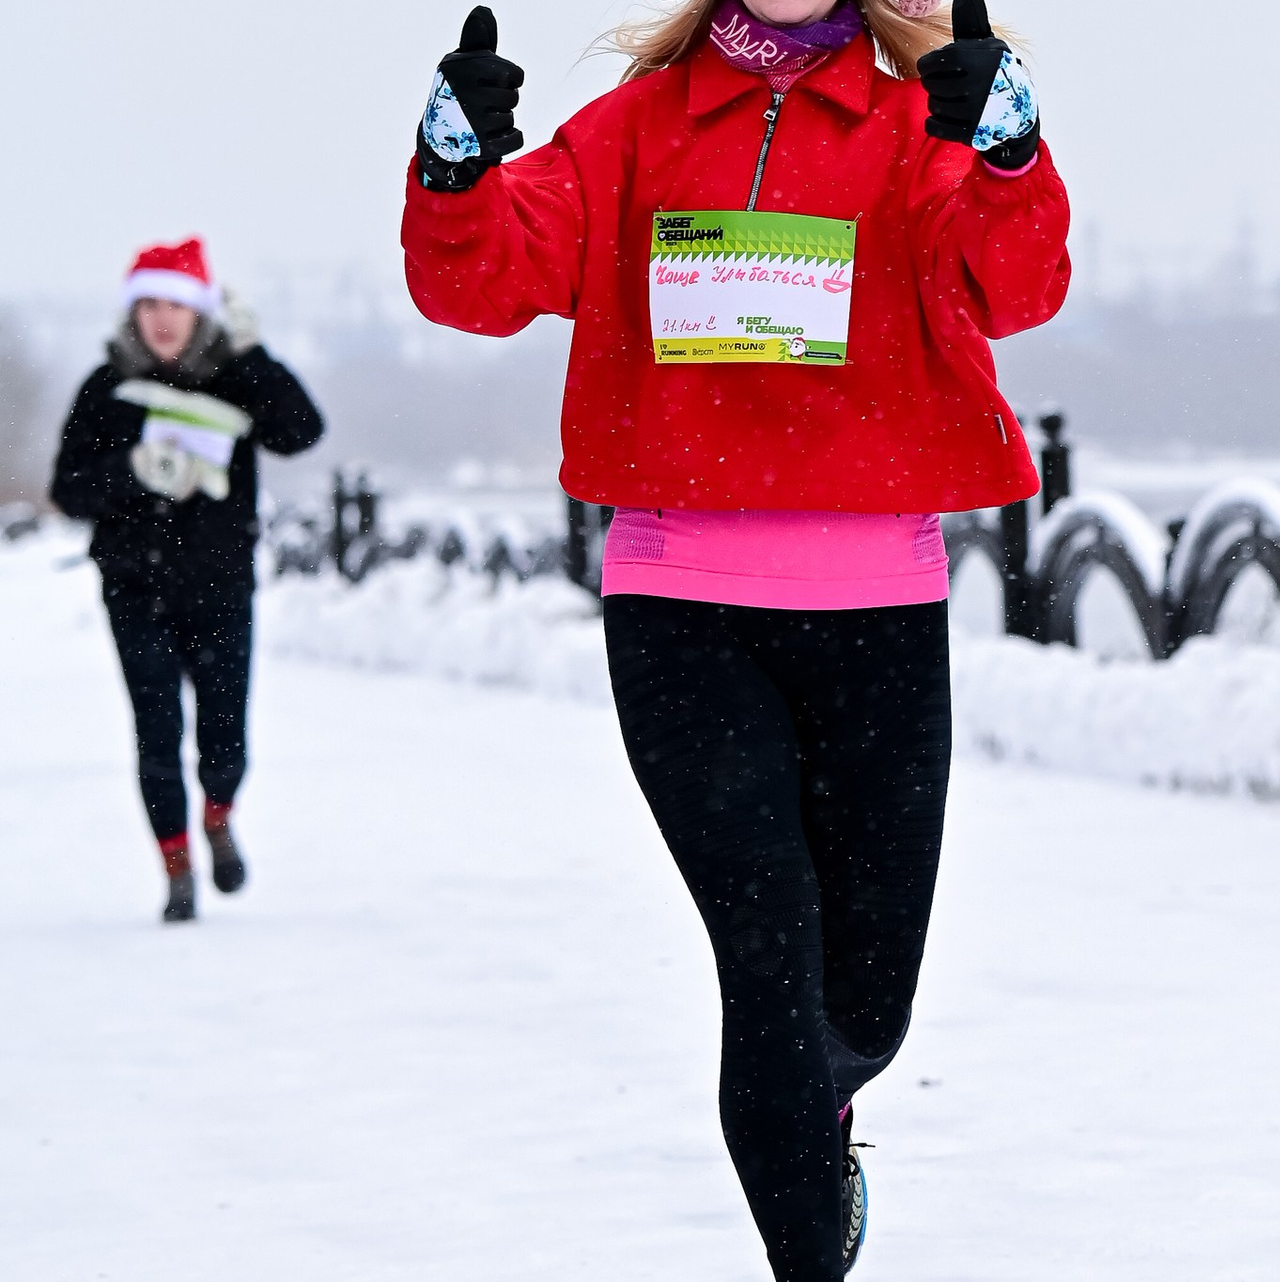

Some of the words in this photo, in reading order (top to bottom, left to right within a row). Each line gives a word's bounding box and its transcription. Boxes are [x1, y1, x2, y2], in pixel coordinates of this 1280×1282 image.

[657, 216, 695, 229] ЗАБЕГ
[657, 224, 724, 245] ОБЕЩАНИЙ
[736, 316, 744, 325] Я
[746, 316, 772, 325] БЕГУ
[745, 325, 753, 334] И
[755, 325, 805, 336] ОБЕЩАЮ
